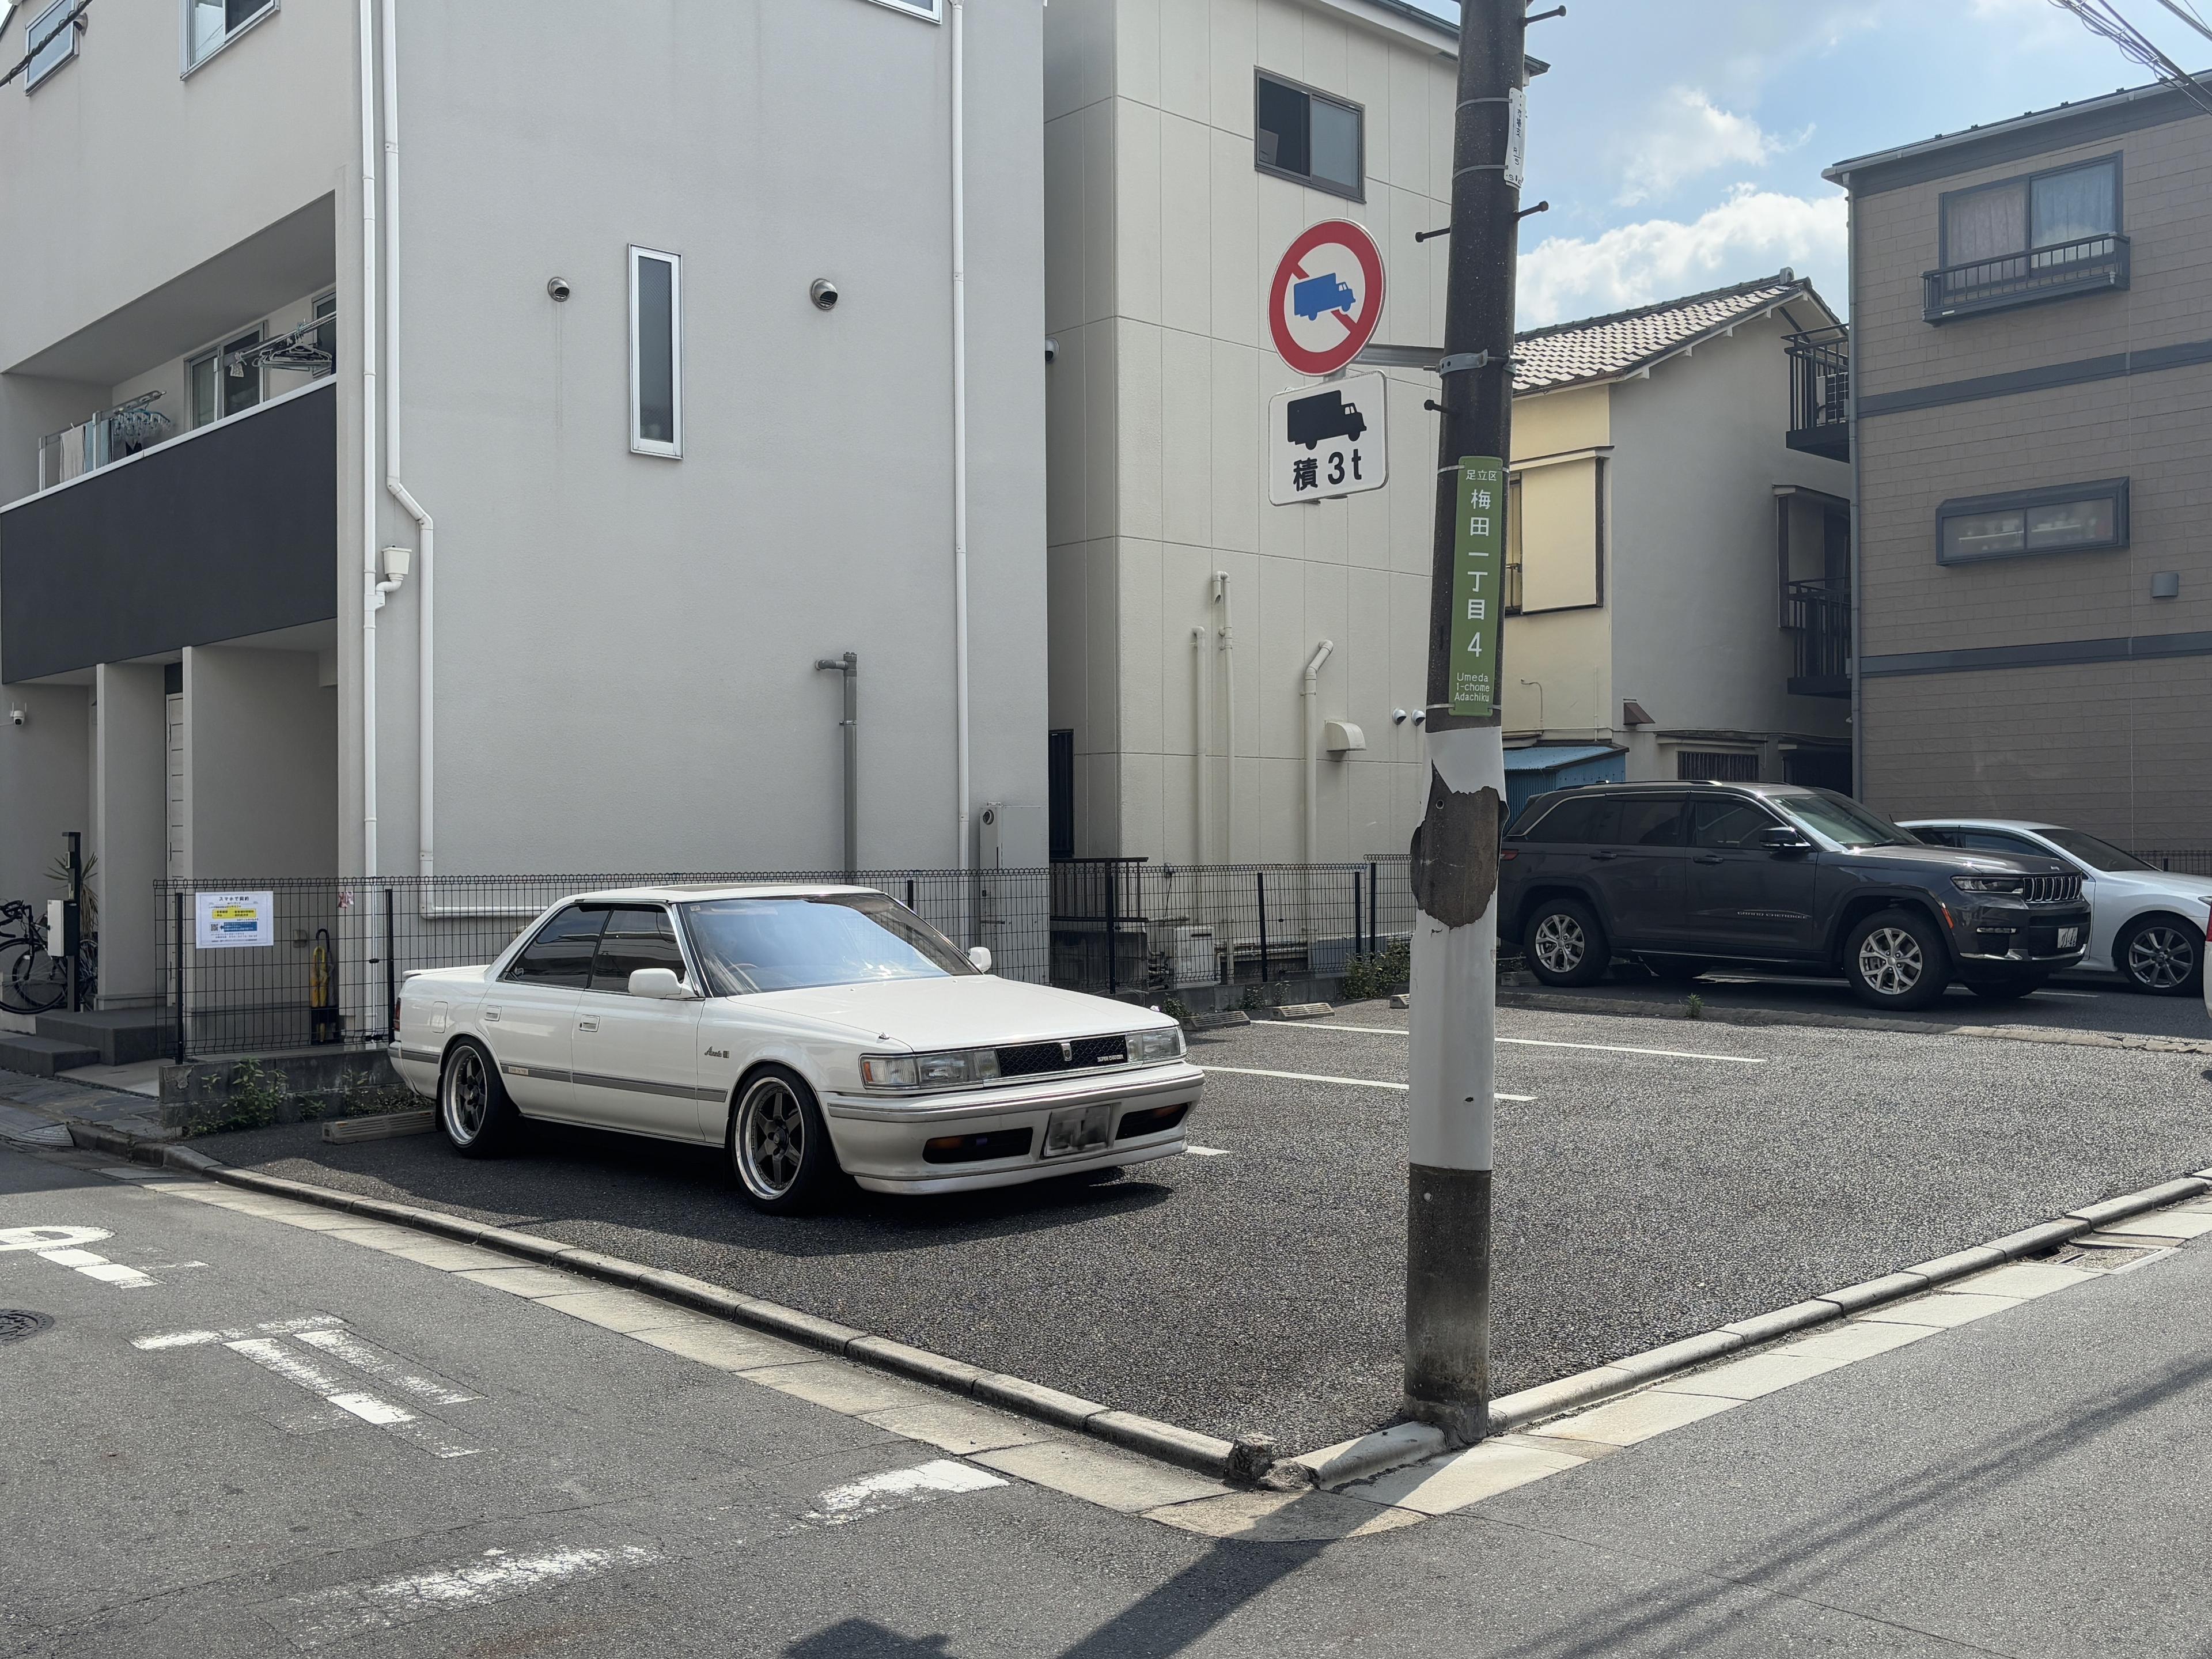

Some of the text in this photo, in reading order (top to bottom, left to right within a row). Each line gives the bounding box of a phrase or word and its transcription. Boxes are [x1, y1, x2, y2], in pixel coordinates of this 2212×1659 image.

[1466, 469, 1497, 481] 足立区
[1457, 672, 1488, 682] Umeda
[1457, 683, 1490, 692] 1-chome
[1454, 692, 1489, 702] Adachiku
